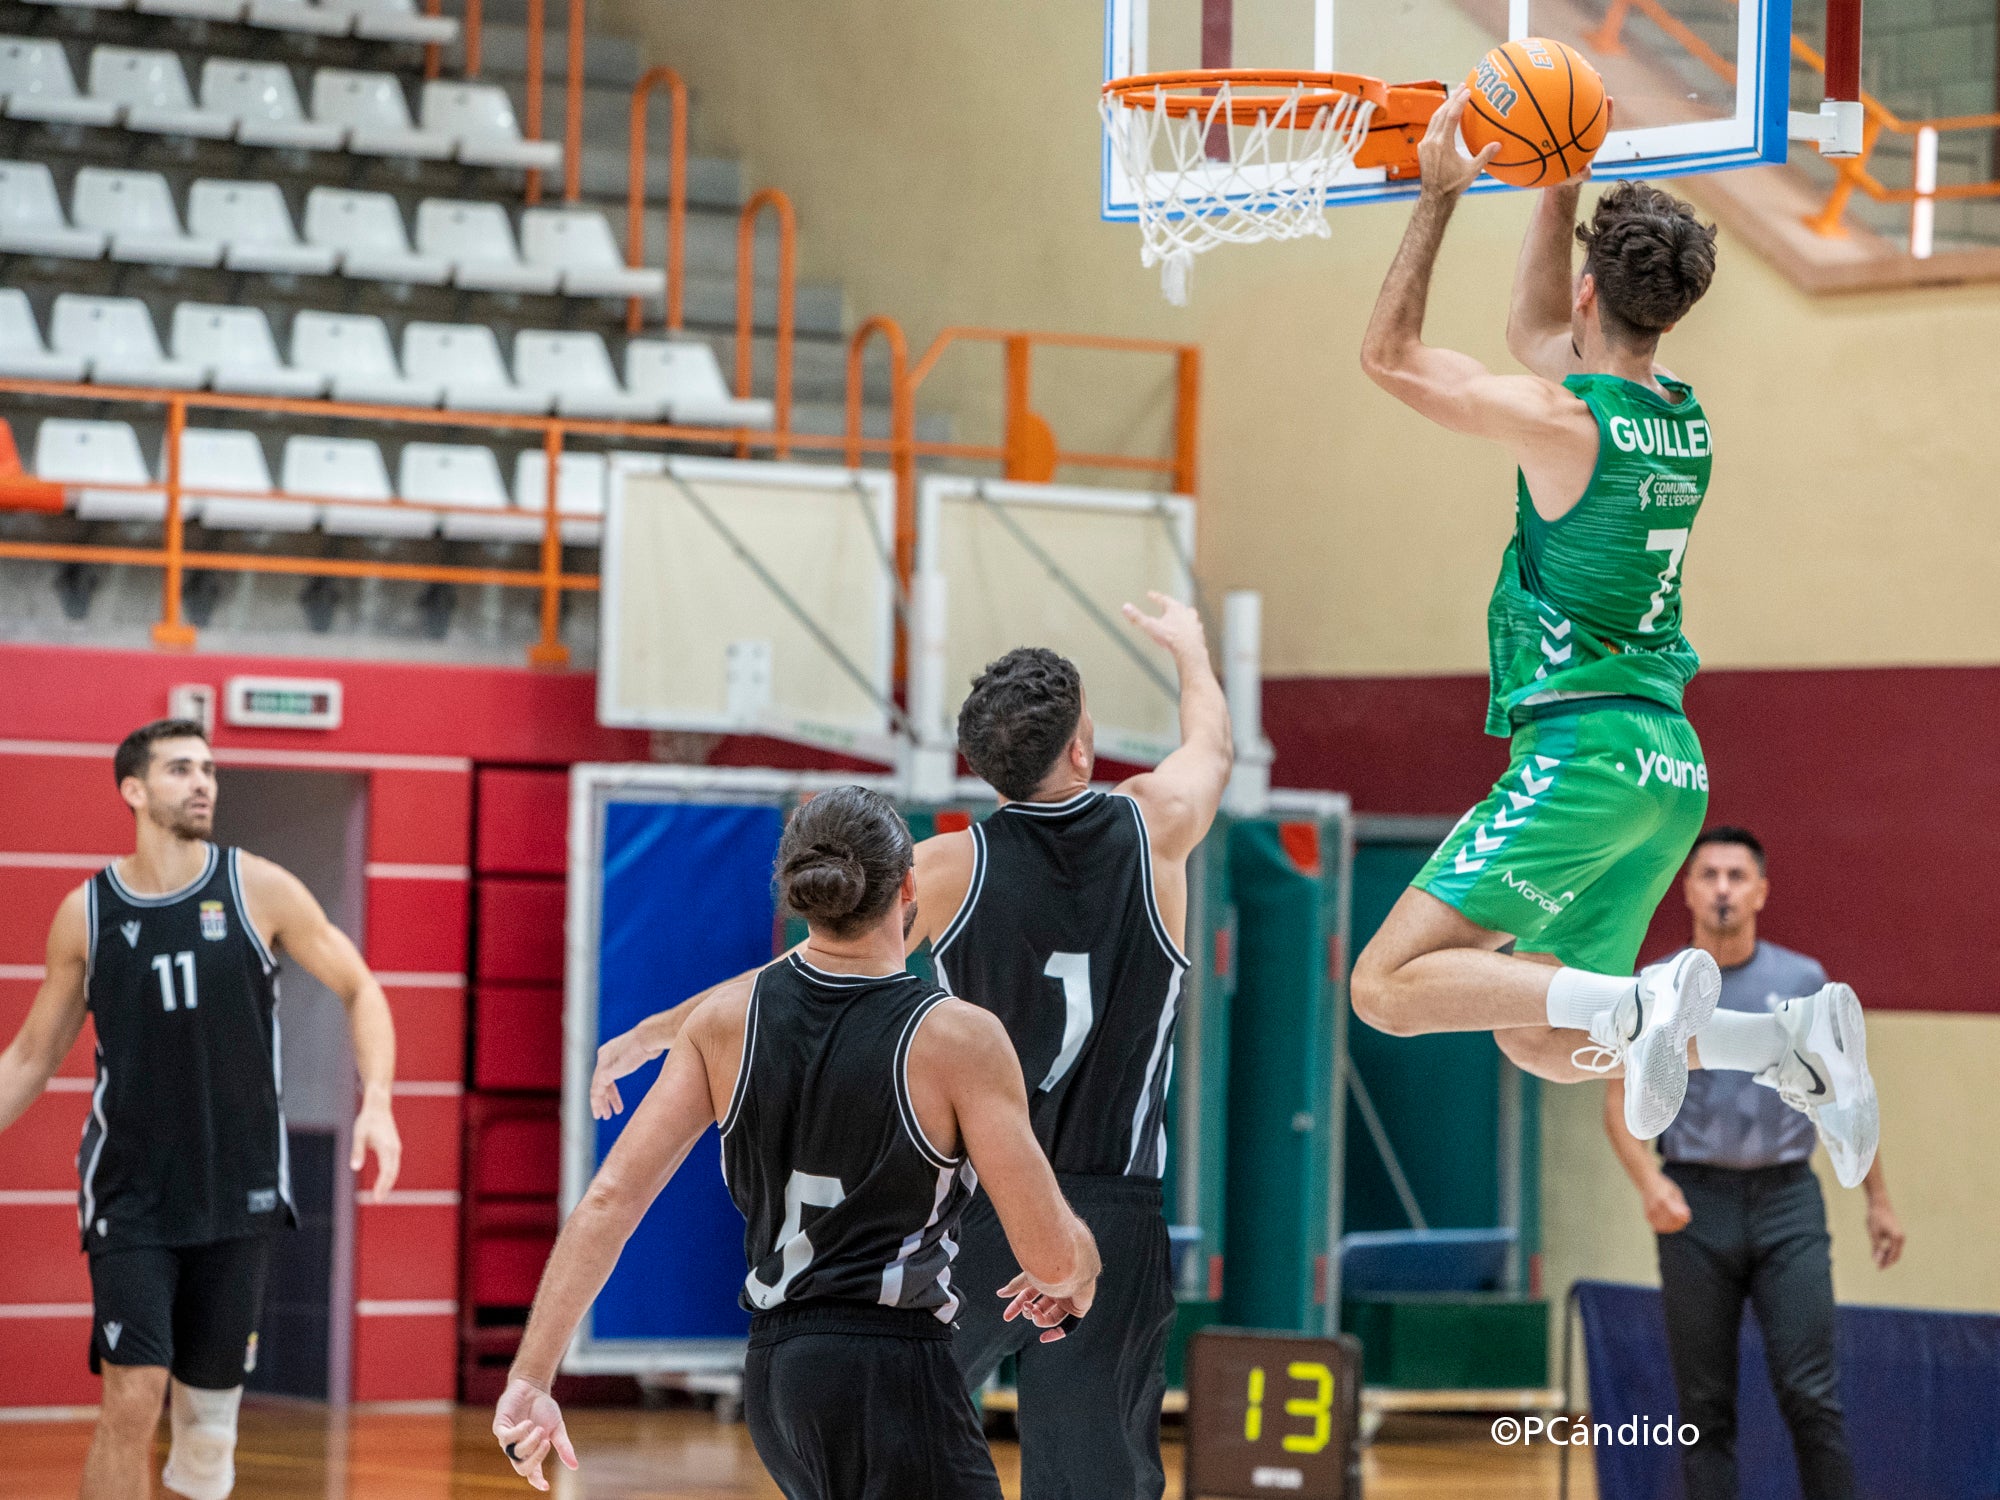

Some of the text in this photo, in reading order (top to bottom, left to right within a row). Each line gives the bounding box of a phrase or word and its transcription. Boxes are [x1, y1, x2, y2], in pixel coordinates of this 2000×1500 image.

[1656, 494, 1668, 506] DE
[1638, 528, 1689, 633] 7
[152, 951, 198, 1011] 11
[1039, 952, 1094, 1092] 1
[745, 1170, 846, 1309] 5
[1245, 1362, 1335, 1453] 13
